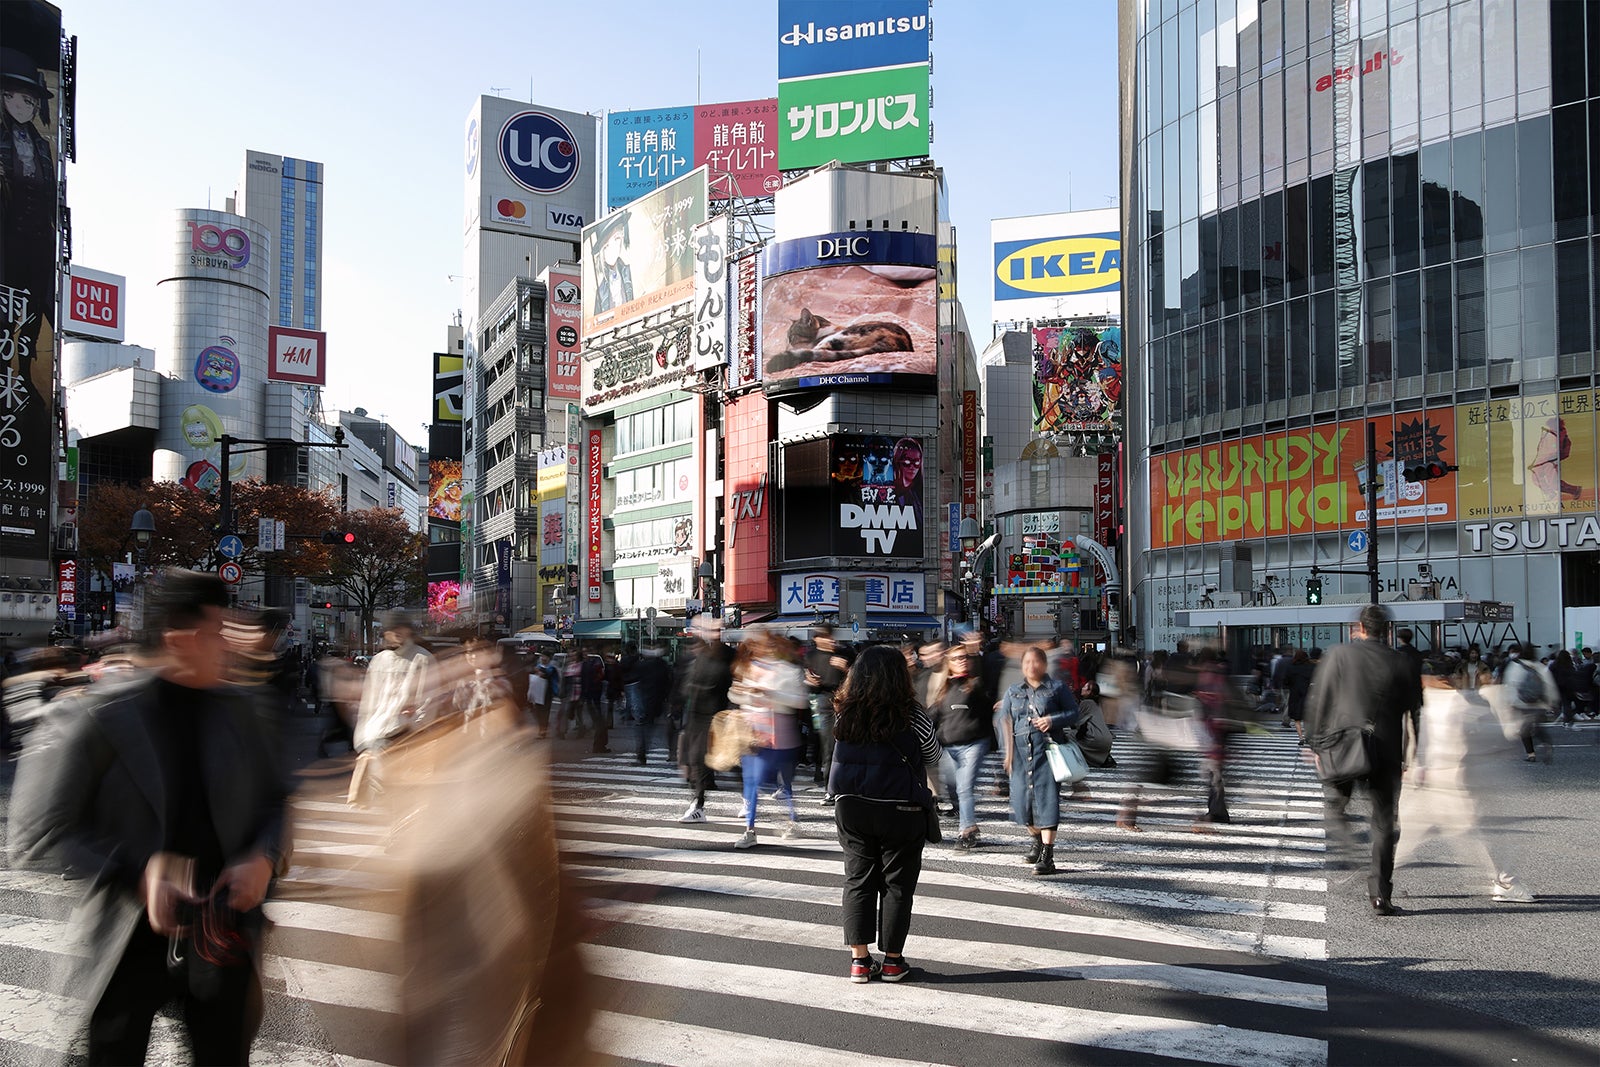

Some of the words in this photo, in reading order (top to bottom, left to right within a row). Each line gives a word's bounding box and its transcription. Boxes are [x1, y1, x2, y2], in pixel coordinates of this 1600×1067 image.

[780, 15, 926, 46] Hisamitsu
[787, 93, 920, 142] サロンパス
[625, 127, 677, 154] 龍角散
[714, 120, 766, 147] 龍角散
[549, 210, 584, 229] VISA
[187, 221, 251, 269] 109
[816, 236, 871, 260] DHC
[190, 254, 229, 270] SHIBUYA
[76, 281, 110, 303] UNI
[697, 225, 726, 362] もんじゃ
[75, 301, 113, 322] QLO
[281, 345, 312, 366] H&M
[819, 376, 838, 385] DHC
[838, 374, 870, 384] Channel
[1161, 427, 1350, 498] VAUNDY
[590, 445, 601, 545] ウィンターフルーツギフト
[1099, 460, 1113, 520] カラオケ
[840, 503, 918, 530] DMM
[1162, 481, 1349, 543] replica
[1469, 505, 1514, 516] SHIBUYA
[1519, 501, 1566, 513] TSUTAYA
[860, 529, 897, 554] TV
[1465, 516, 1600, 552] TSUTA
